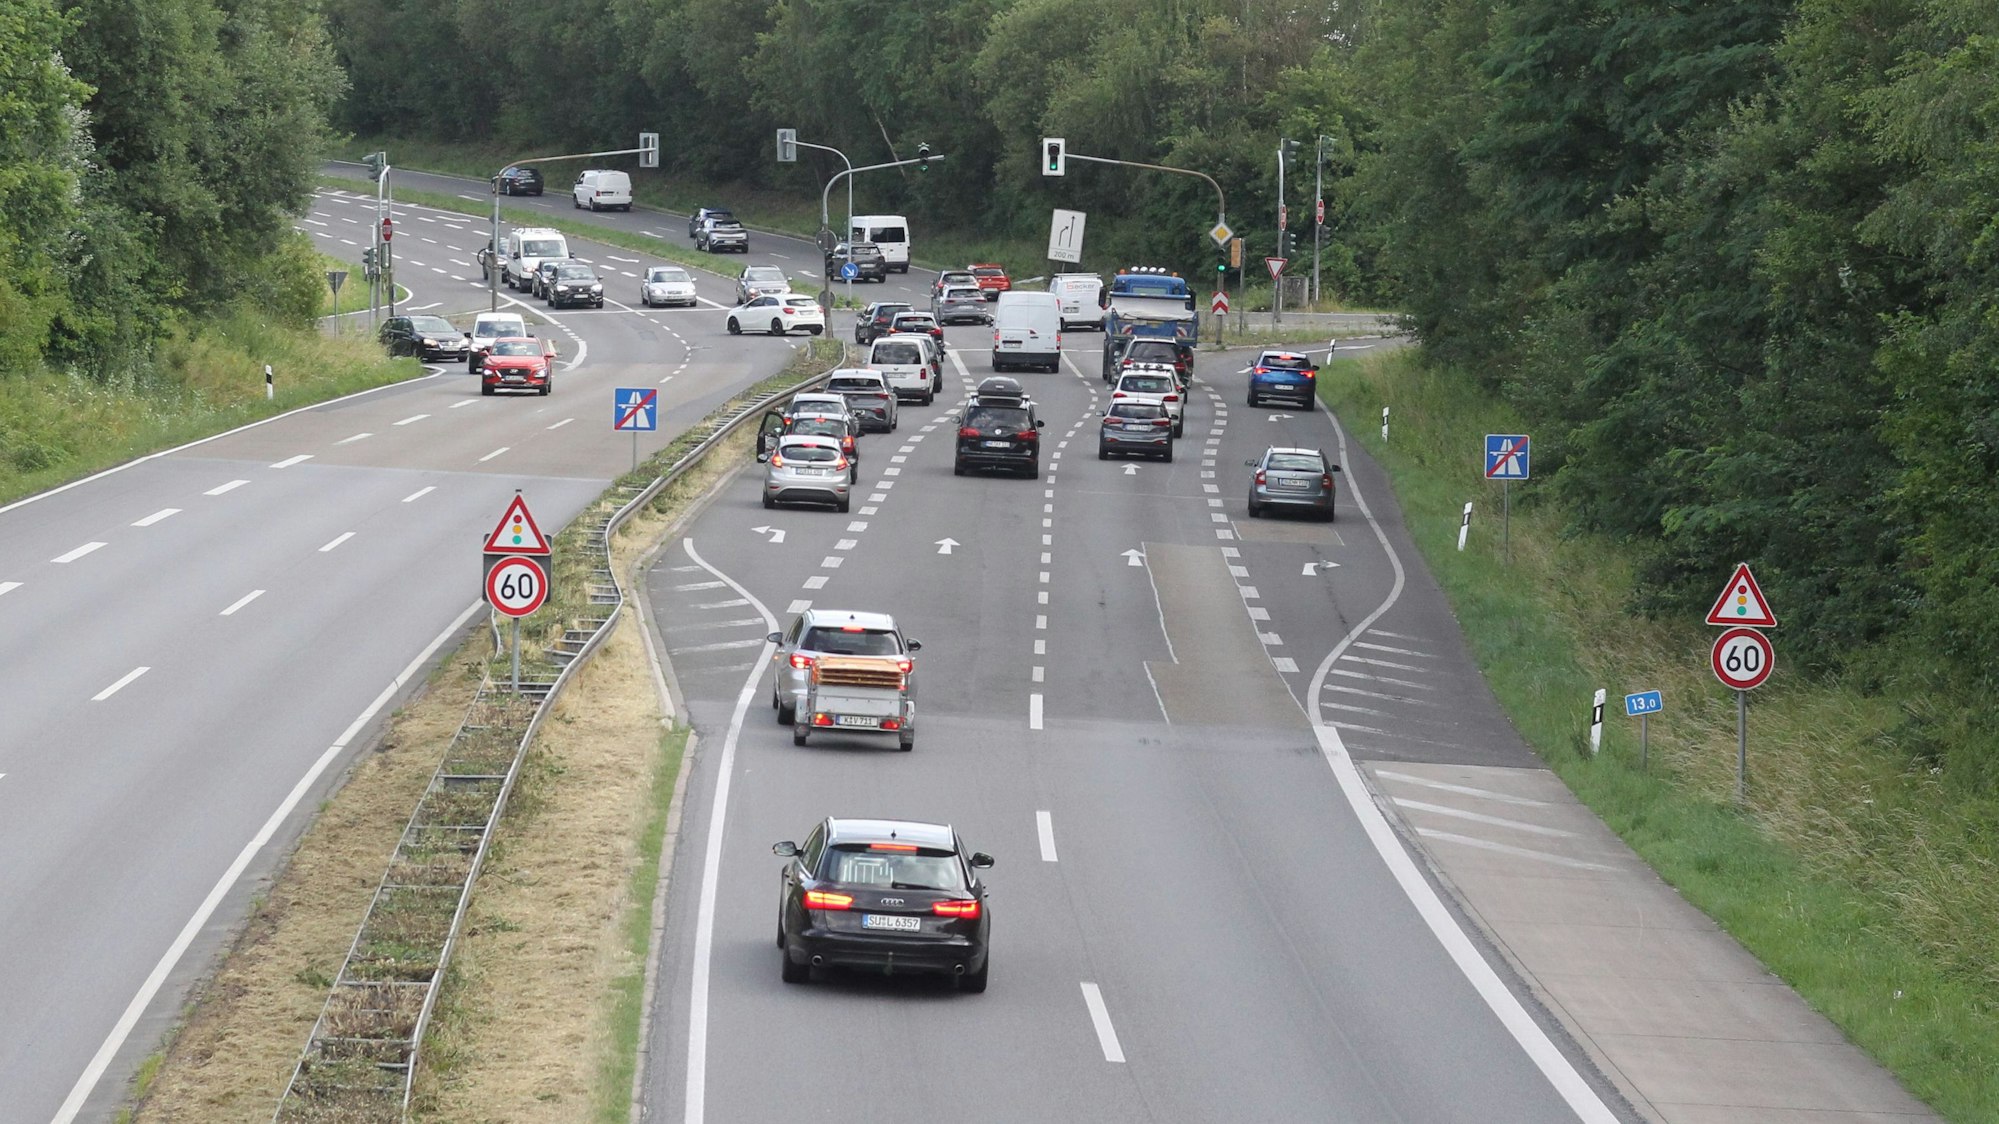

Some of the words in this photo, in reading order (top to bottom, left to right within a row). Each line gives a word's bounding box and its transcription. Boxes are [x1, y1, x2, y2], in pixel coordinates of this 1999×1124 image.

[1054, 250, 1066, 259] 200
[501, 573, 534, 600] 60
[1726, 645, 1759, 672] 60
[1631, 697, 1656, 711] 13,0
[895, 916, 919, 928] 6357
